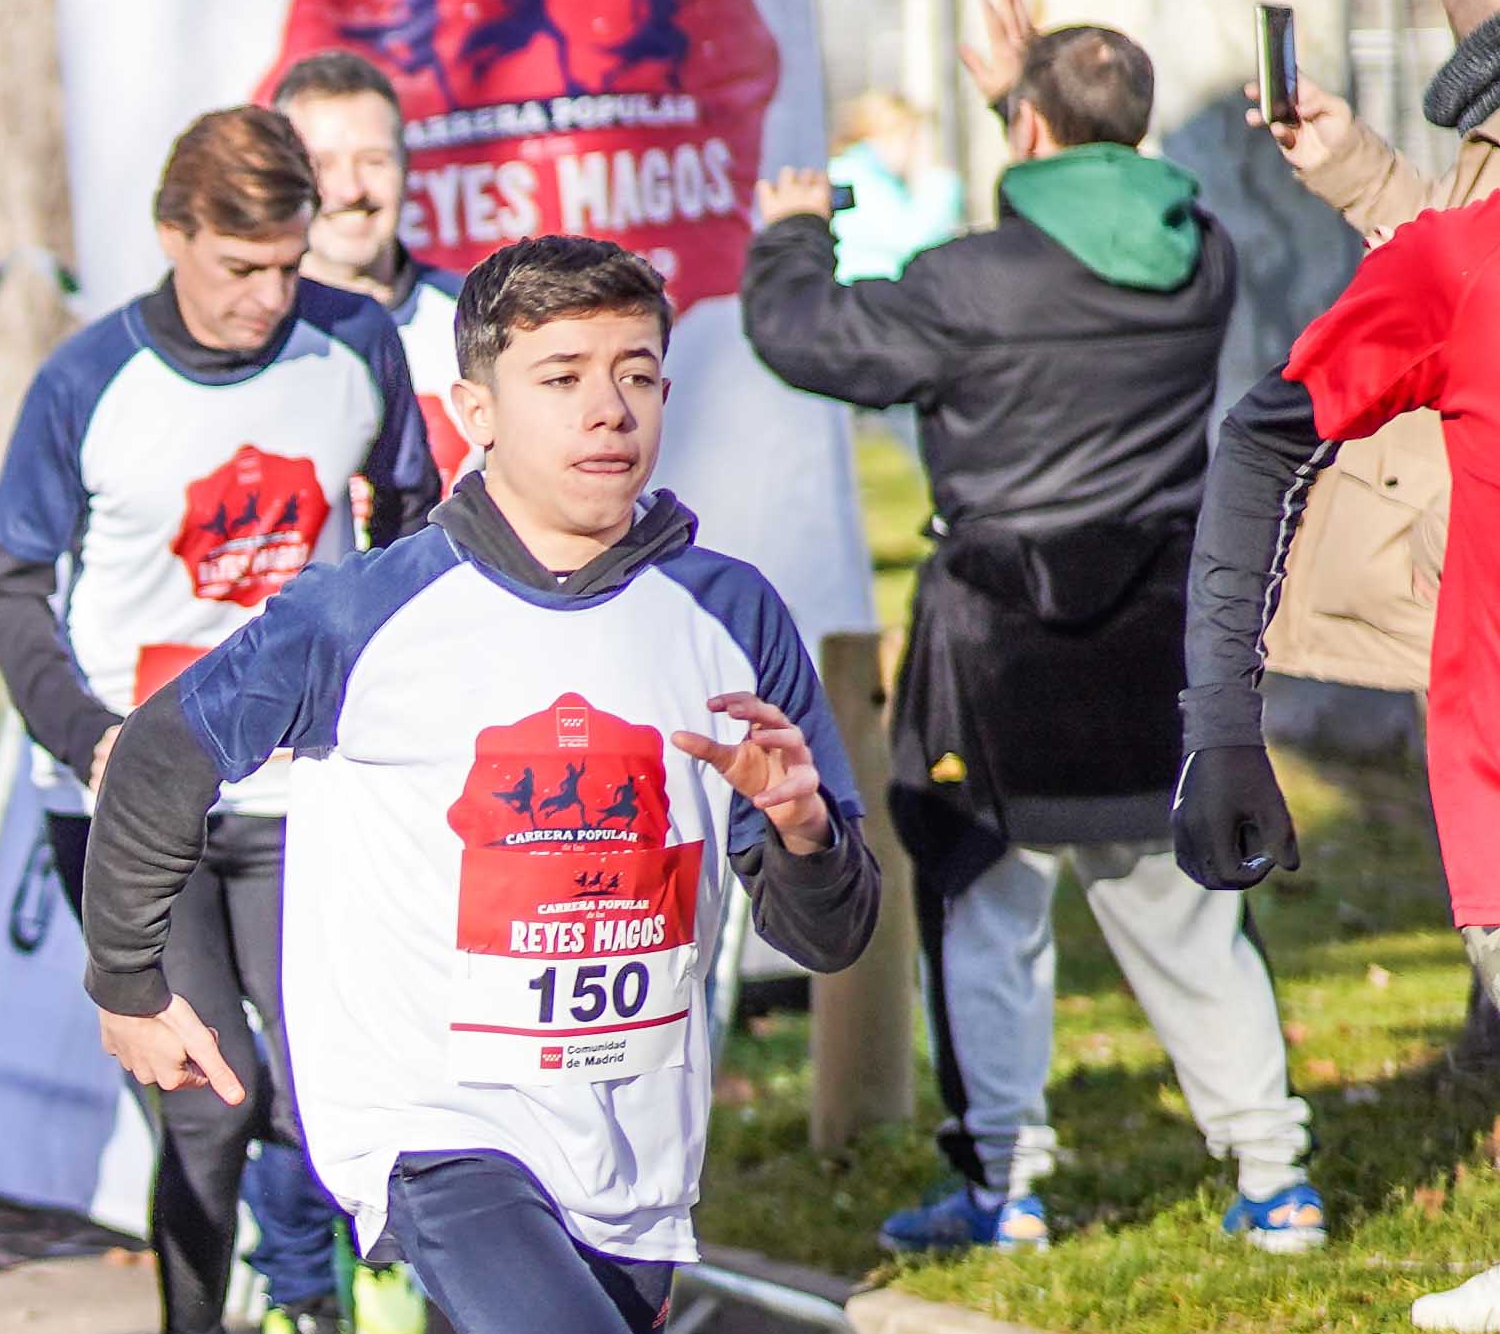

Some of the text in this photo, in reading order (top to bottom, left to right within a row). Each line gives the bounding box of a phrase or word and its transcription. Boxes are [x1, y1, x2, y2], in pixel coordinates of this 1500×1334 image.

[403, 98, 549, 150] ARRERA
[399, 137, 735, 249] EYES MAGOS
[505, 828, 638, 845] CARRERA POPULAR
[537, 900, 595, 915] CARRERA
[510, 914, 666, 954] REYES MAGOS
[528, 960, 650, 1024] 150
[566, 1052, 625, 1069] de Madrid
[567, 1039, 627, 1055] Comunidad
